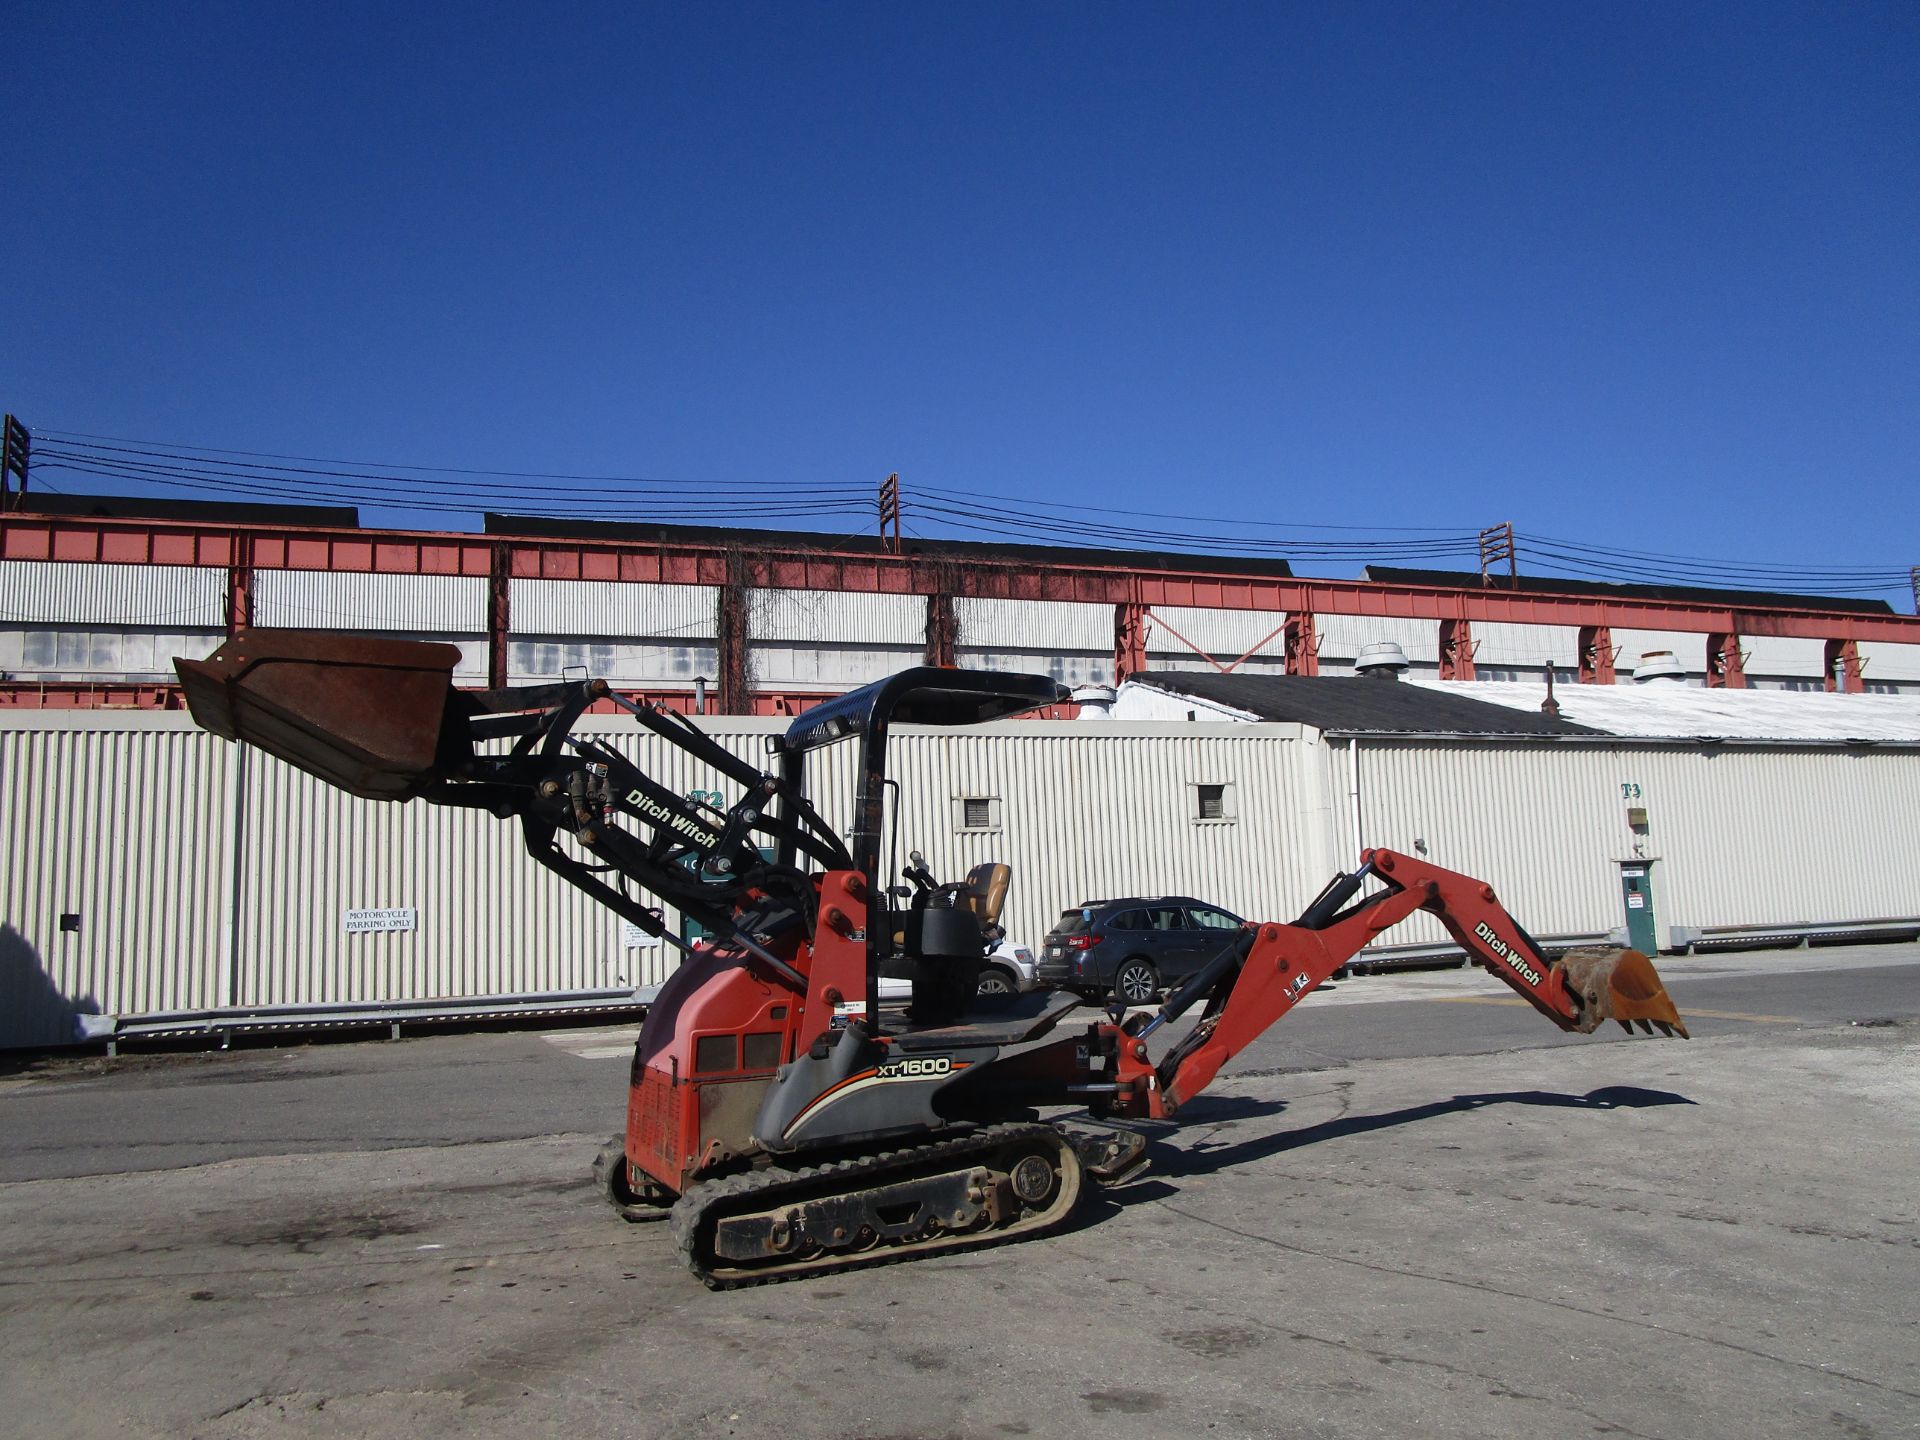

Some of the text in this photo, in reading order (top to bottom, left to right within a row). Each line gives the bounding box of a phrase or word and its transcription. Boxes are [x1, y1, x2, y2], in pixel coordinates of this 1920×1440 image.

[625, 789, 717, 848] Ditch Witch
[346, 919, 411, 929] PARKING ONLY
[349, 911, 408, 920] MOTORCYCLE
[1474, 921, 1541, 986] Ditch Witch
[878, 1058, 950, 1076] XT1600
